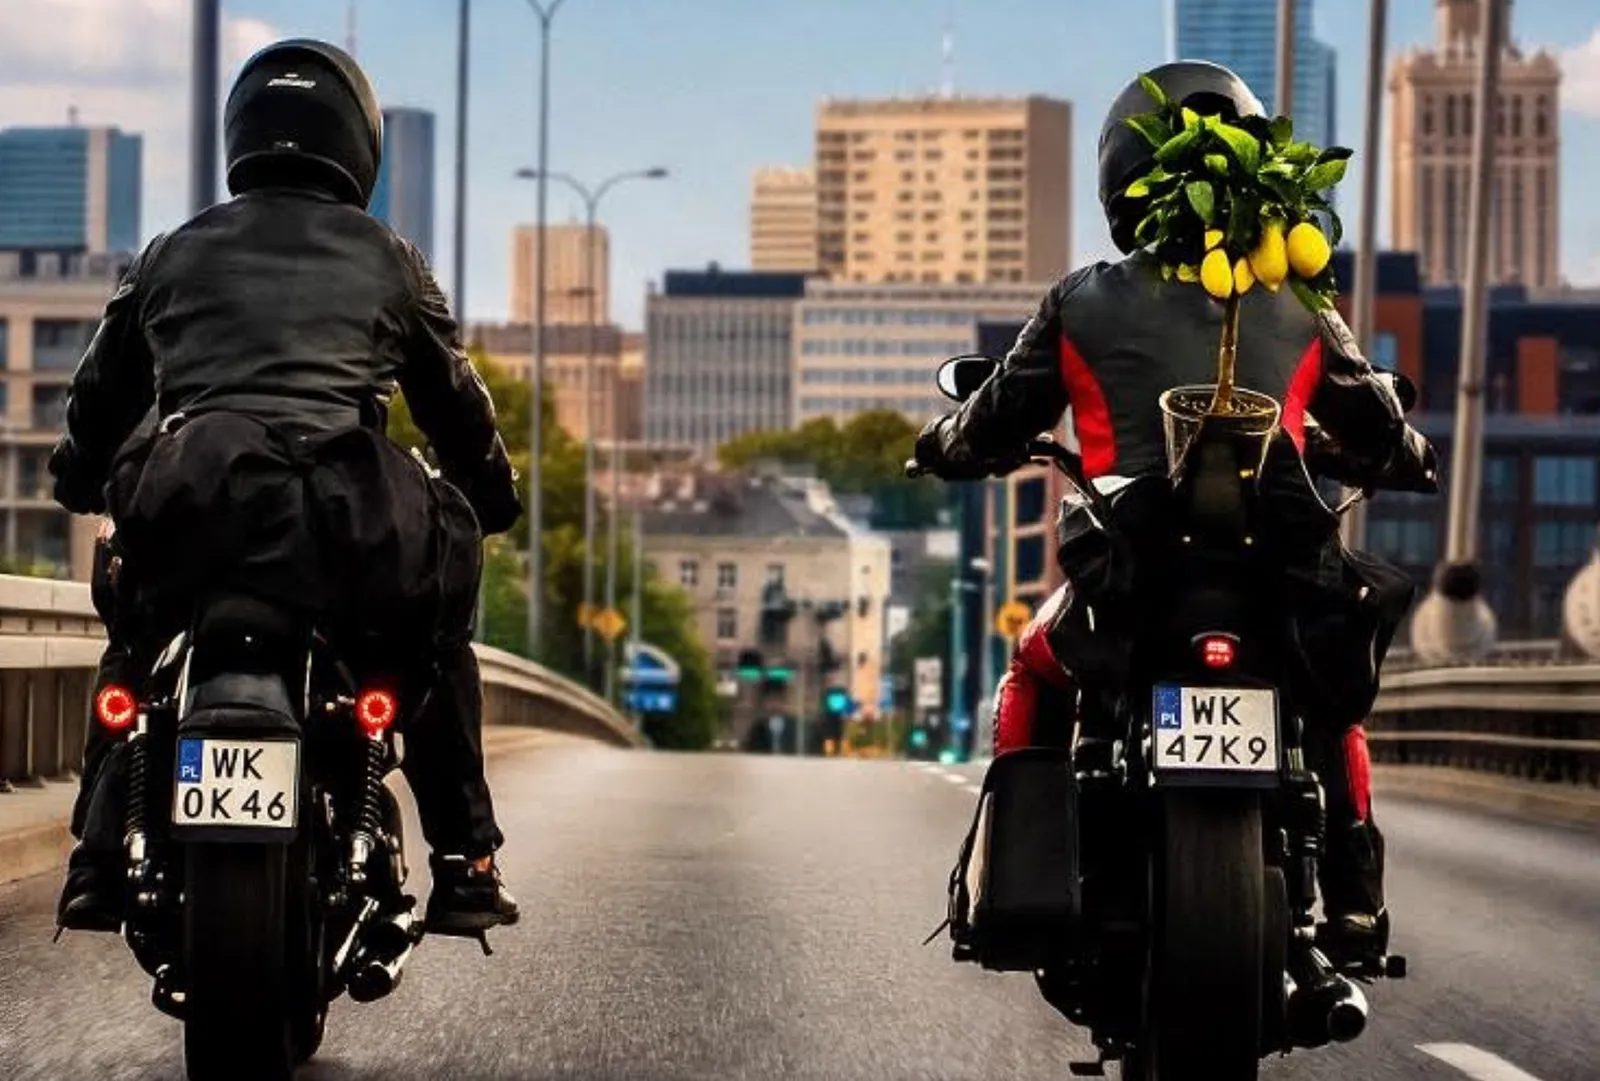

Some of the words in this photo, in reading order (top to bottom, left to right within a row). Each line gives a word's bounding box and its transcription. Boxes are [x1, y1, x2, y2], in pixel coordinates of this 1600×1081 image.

[1160, 713, 1178, 725] PL
[1191, 695, 1241, 725] WK
[212, 748, 263, 779] WK
[1165, 735, 1267, 764] 47K9
[182, 765, 198, 778] PL
[183, 787, 286, 821] 0K46
